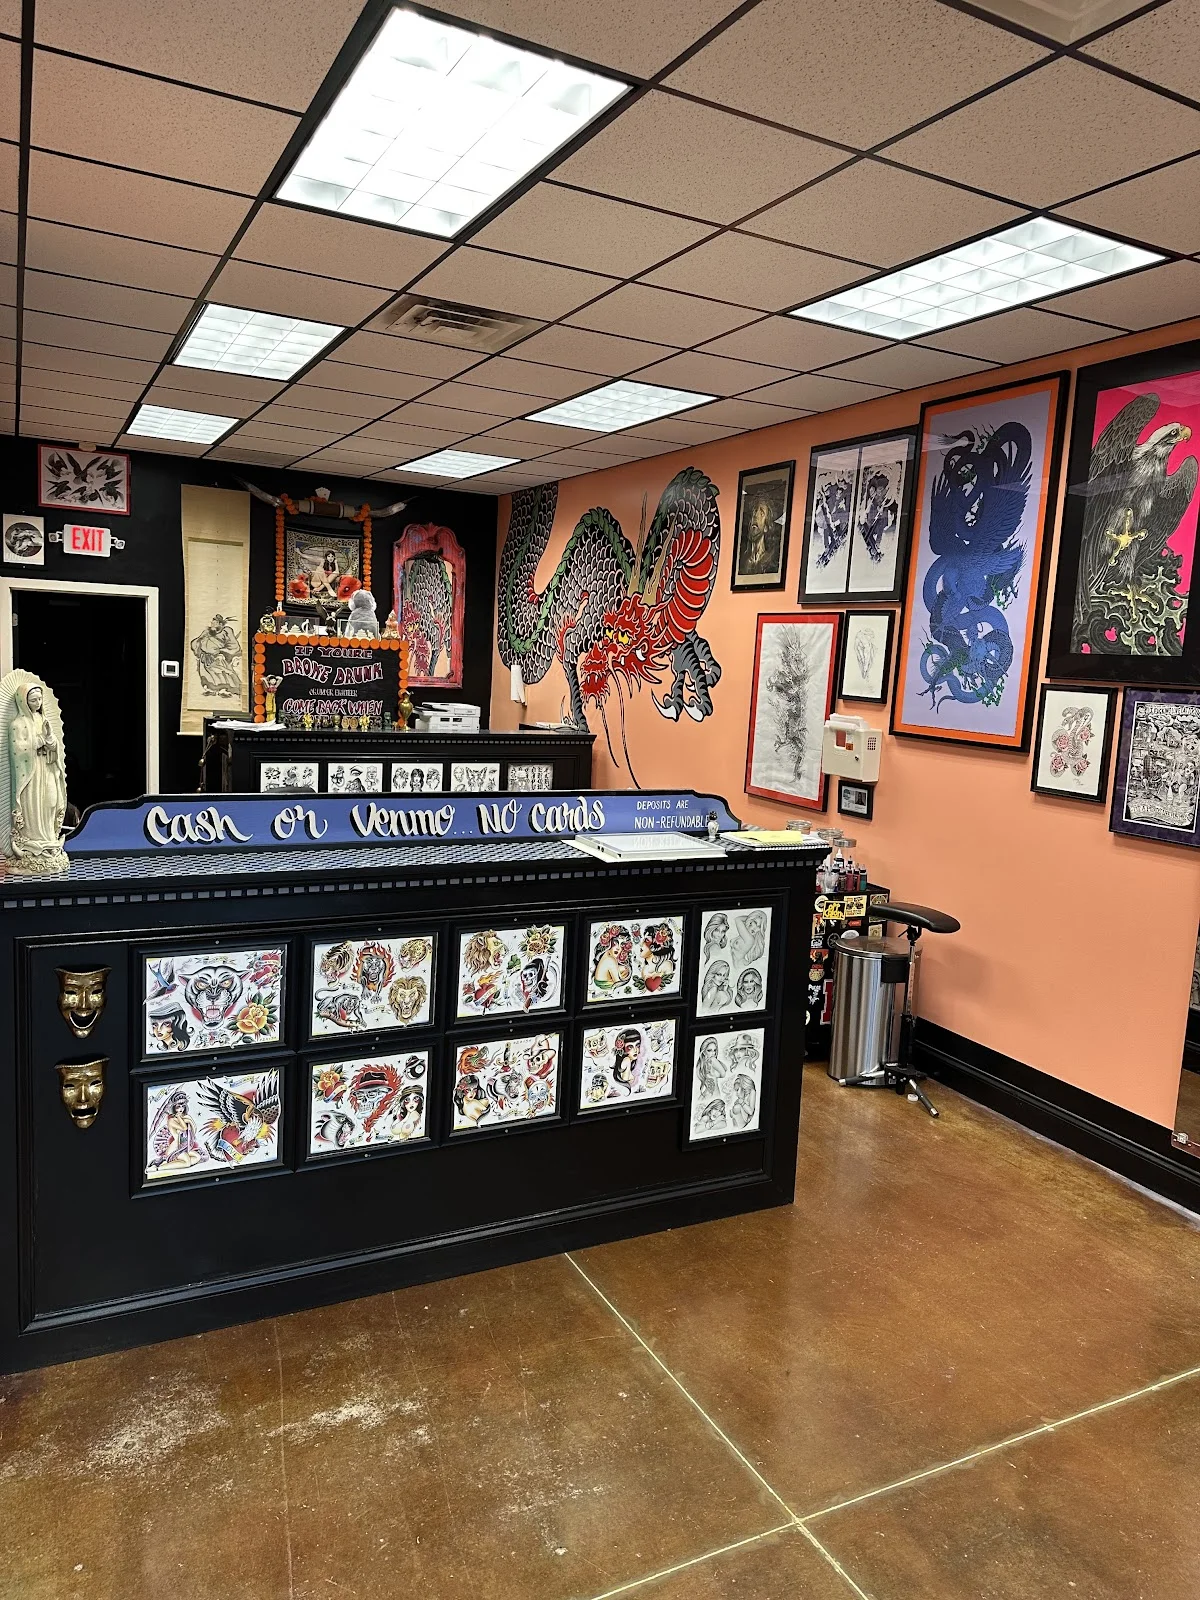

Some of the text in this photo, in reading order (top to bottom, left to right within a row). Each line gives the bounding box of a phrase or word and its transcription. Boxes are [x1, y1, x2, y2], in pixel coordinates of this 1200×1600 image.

[72, 526, 104, 551] EXIT
[294, 645, 315, 656] IF
[281, 656, 384, 686] BROKE DRUNK
[282, 698, 384, 716] COME BACK WHEN
[636, 799, 690, 811] DEPOSITS ARE
[144, 804, 254, 846] Cash
[271, 803, 329, 841] or
[478, 798, 522, 834] NO
[634, 814, 710, 830] NON-REFUNDABLE
